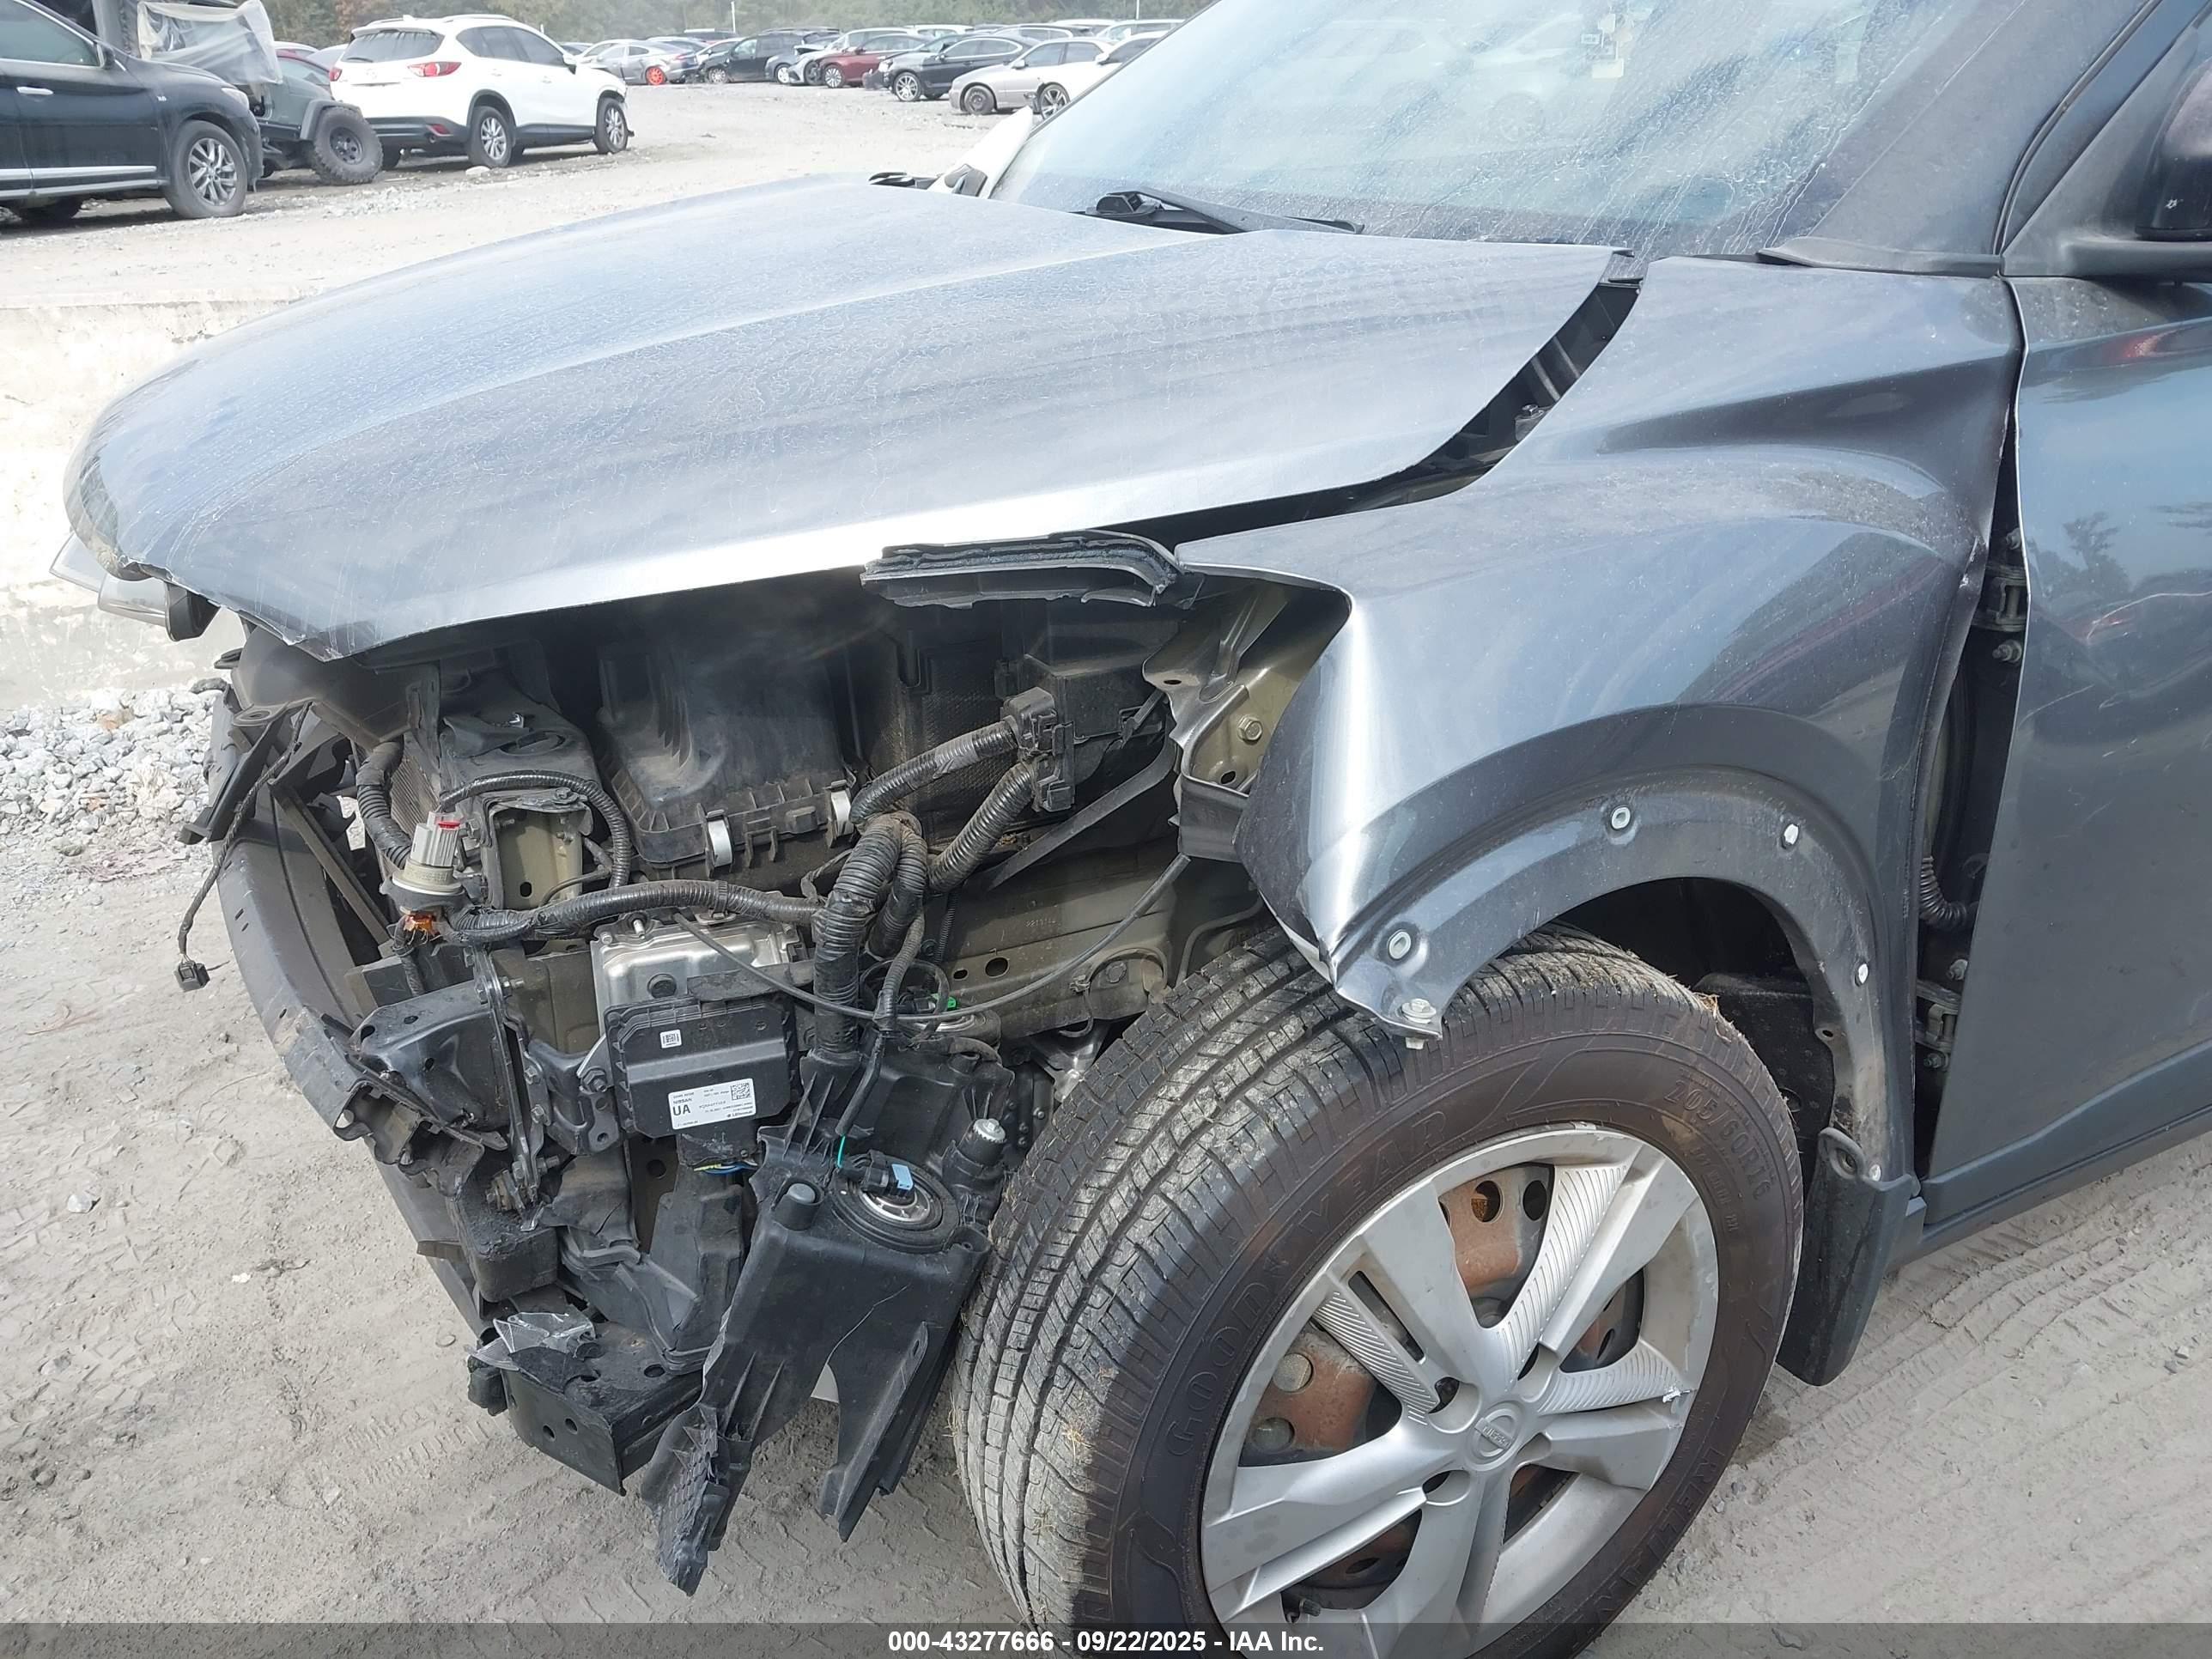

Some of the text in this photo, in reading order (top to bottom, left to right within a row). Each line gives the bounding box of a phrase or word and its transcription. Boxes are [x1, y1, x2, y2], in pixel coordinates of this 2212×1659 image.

[672, 1104, 691, 1116] UA
[1663, 1079, 1771, 1200] 205/60R16
[1165, 1106, 1449, 1457] GOODYEAR
